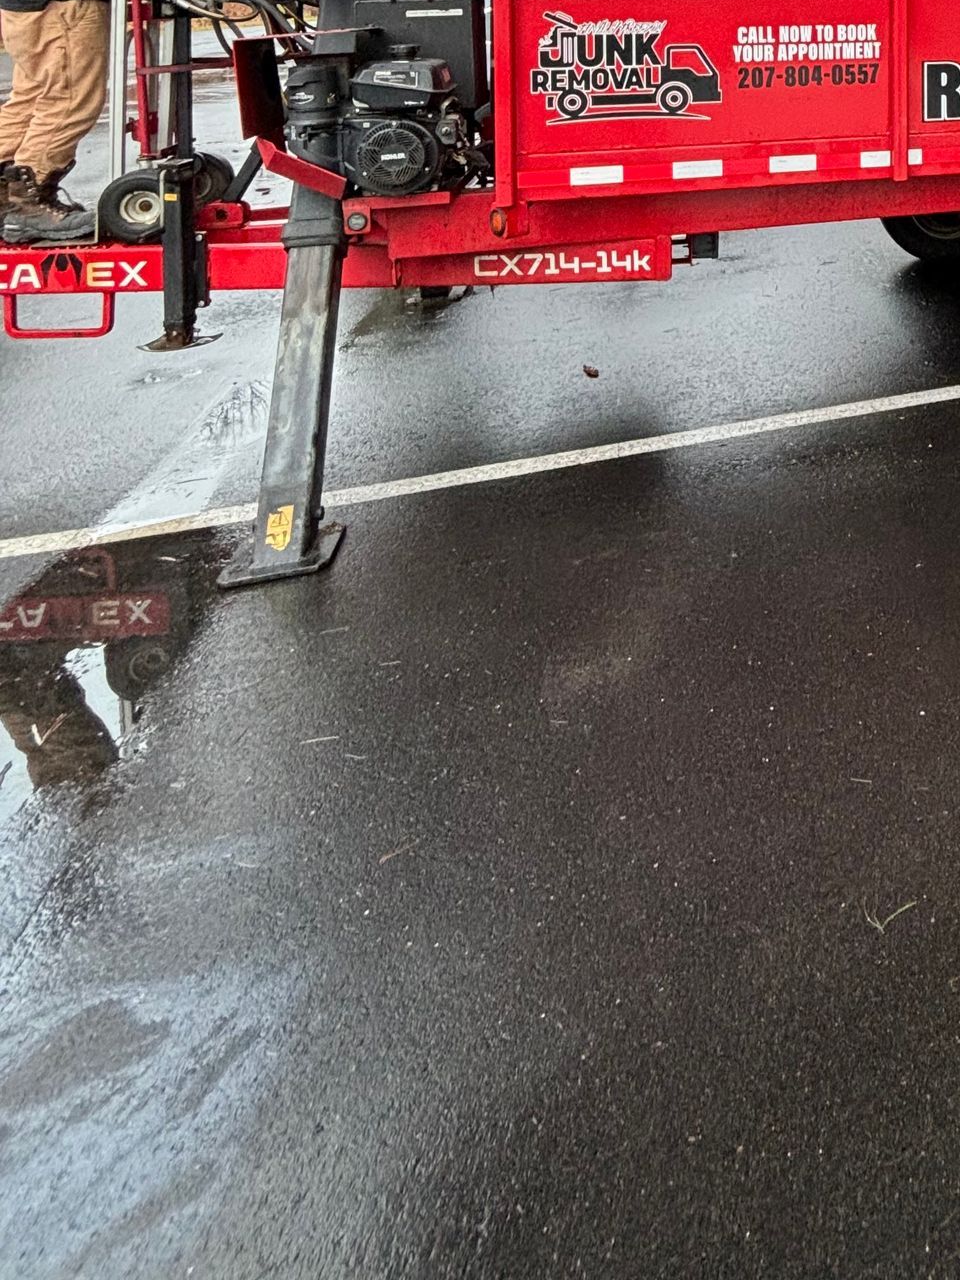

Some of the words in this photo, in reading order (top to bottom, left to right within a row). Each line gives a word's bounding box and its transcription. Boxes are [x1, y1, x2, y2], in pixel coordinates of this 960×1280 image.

[737, 26, 775, 44] CALL
[779, 25, 812, 43] NOW
[815, 24, 834, 42] TO
[837, 23, 877, 42] BOOK
[538, 26, 665, 70] JUNK
[732, 44, 774, 63] YOUR
[777, 42, 881, 62] APPOINTMENT
[530, 66, 662, 94] REMOVAL
[738, 63, 879, 89] 207-804-0557
[474, 249, 651, 277] CX714-14k
